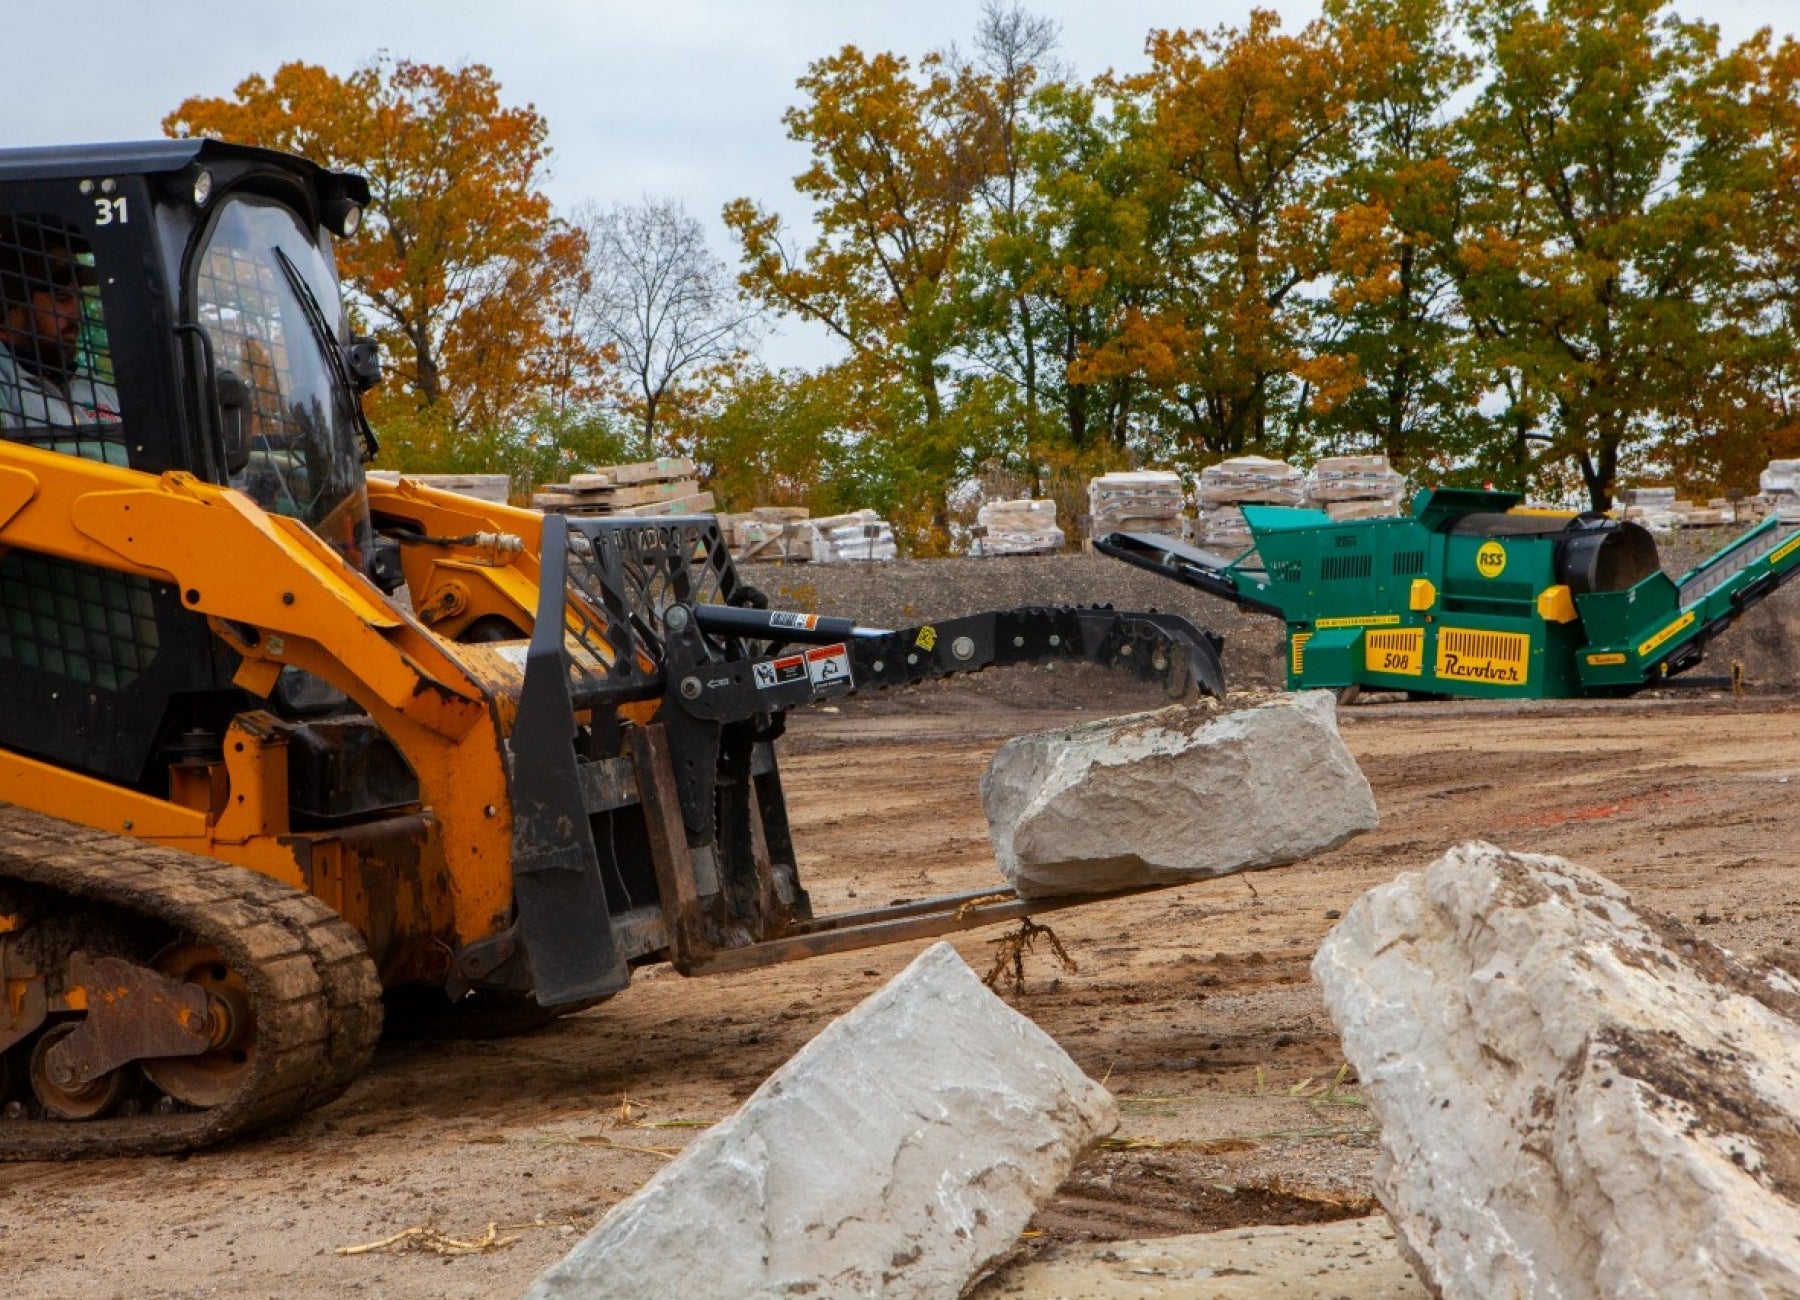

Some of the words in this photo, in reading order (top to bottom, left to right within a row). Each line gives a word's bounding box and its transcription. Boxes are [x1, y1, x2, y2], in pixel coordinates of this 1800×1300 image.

[95, 197, 128, 225] 31
[1480, 552, 1503, 566] RSS
[1384, 653, 1409, 669] 508
[1444, 653, 1519, 681] Revolver
